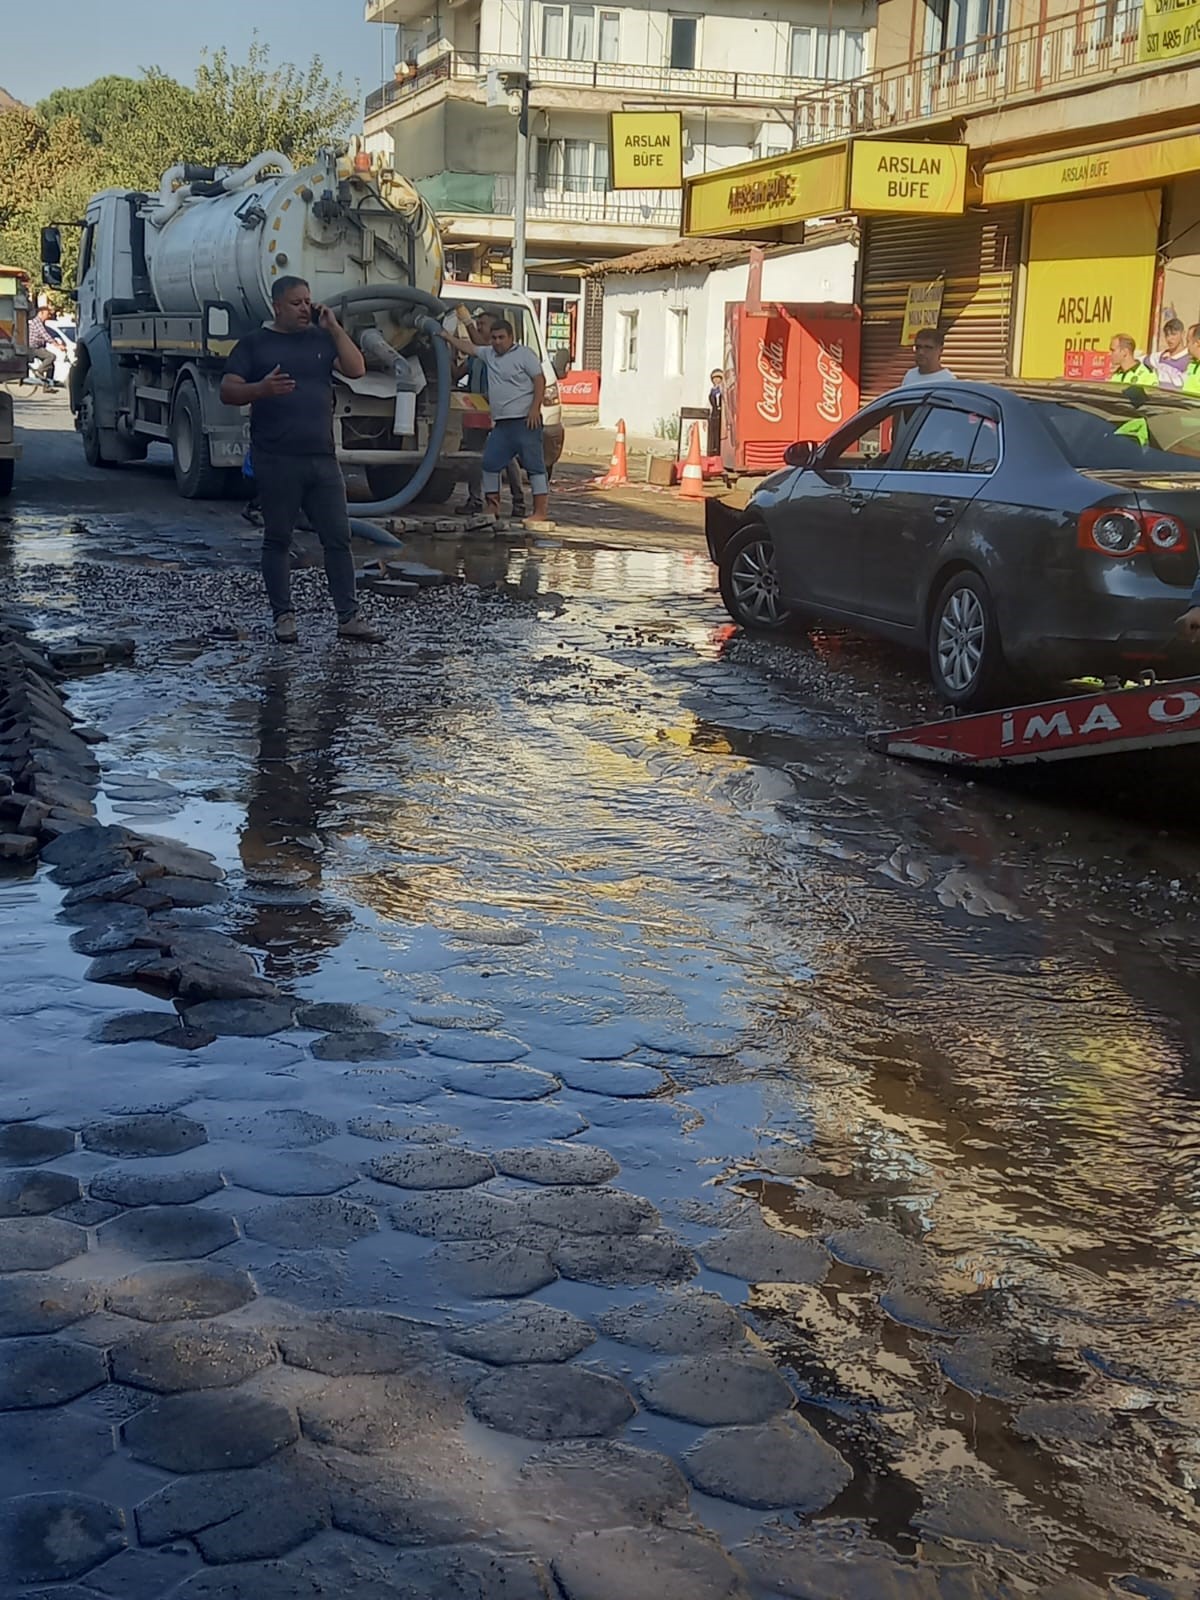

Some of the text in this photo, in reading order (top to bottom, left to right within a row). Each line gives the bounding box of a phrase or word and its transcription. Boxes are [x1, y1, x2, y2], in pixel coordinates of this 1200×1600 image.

[1163, 28, 1182, 50] 485
[624, 134, 671, 148] ARSLAN
[632, 151, 664, 167] BÜFE
[876, 155, 942, 176] ARSLAN
[1061, 160, 1110, 183] ARSLAN BÜFE
[888, 177, 930, 199] BÜFE
[1057, 295, 1113, 324] ARSLAN
